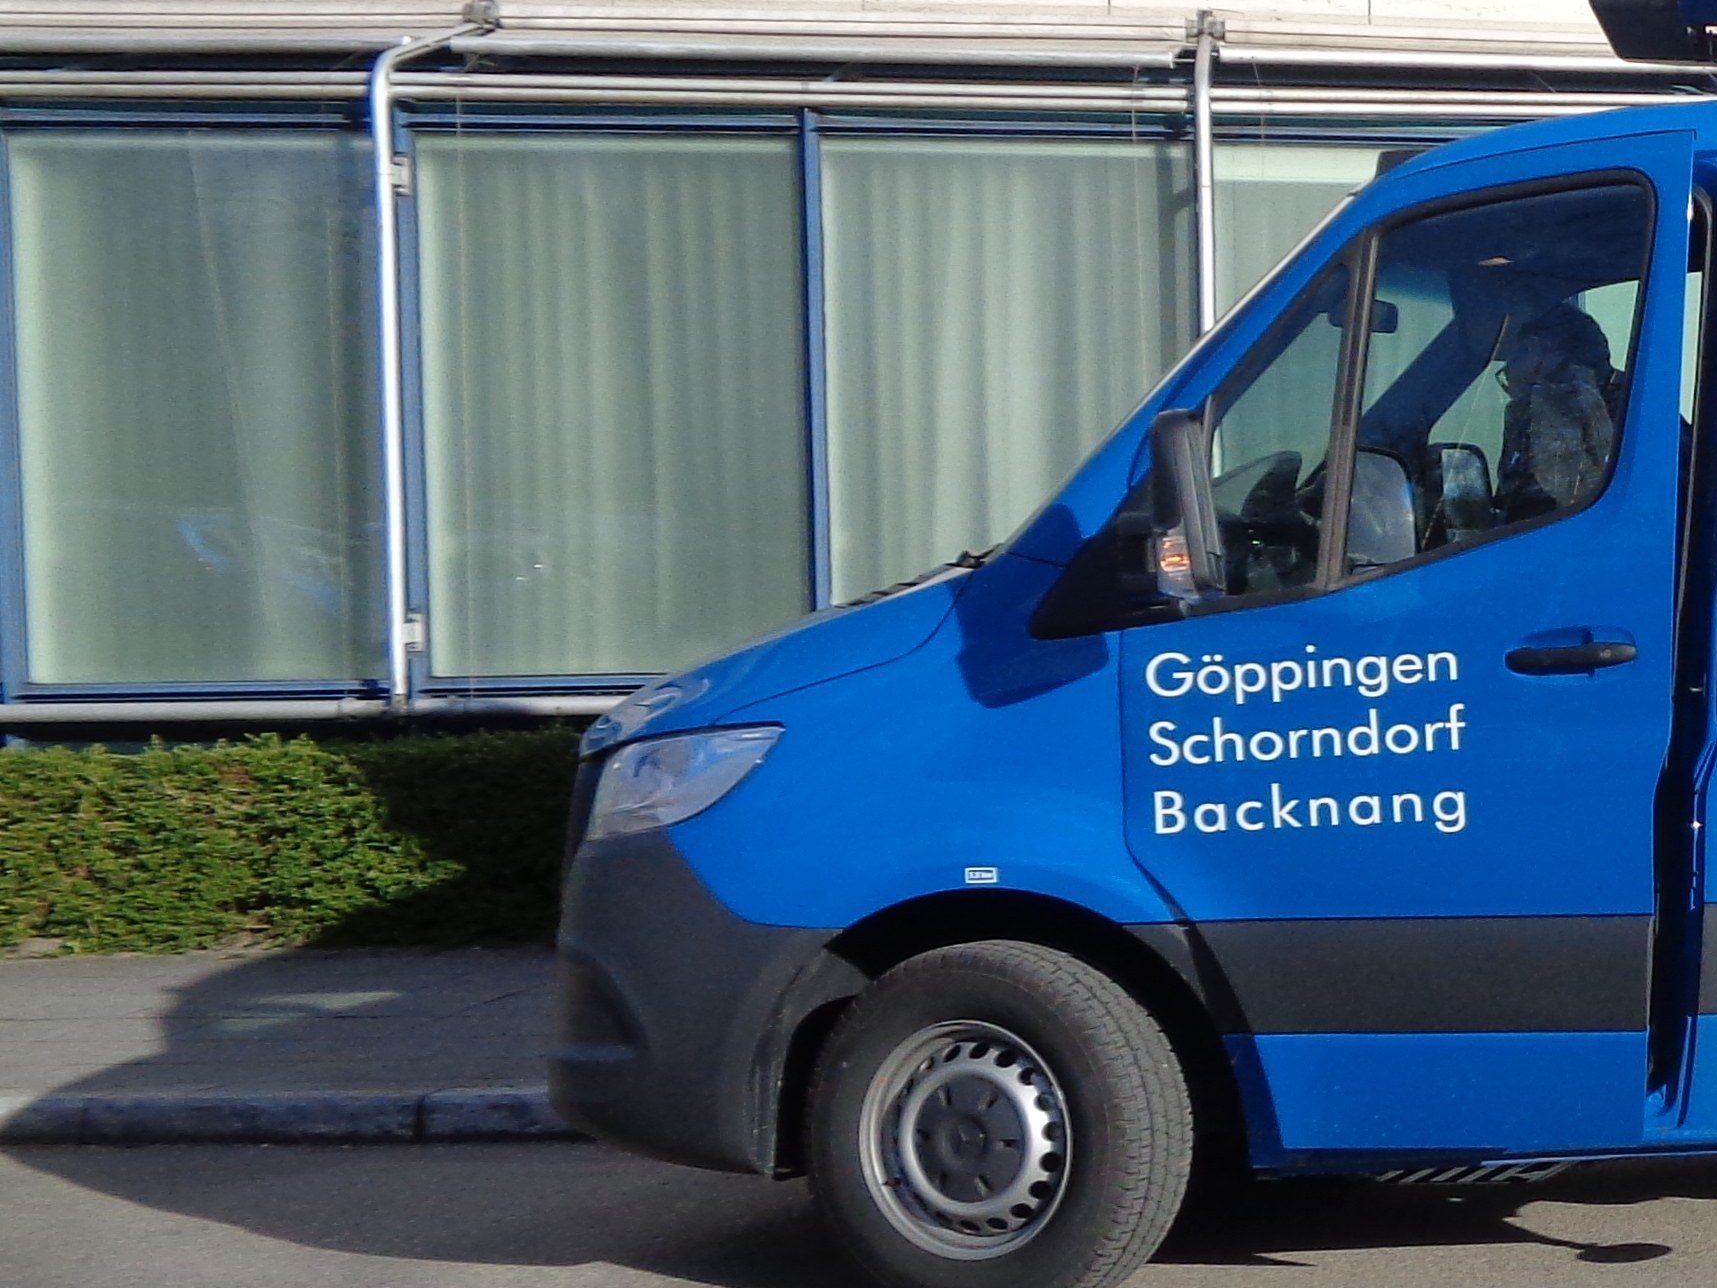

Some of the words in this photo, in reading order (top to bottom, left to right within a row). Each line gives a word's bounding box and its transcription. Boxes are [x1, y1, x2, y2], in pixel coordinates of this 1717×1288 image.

[1145, 644, 1460, 704] Göppingen
[1148, 703, 1467, 767] Schorndorf
[1153, 783, 1467, 834] Backnang
